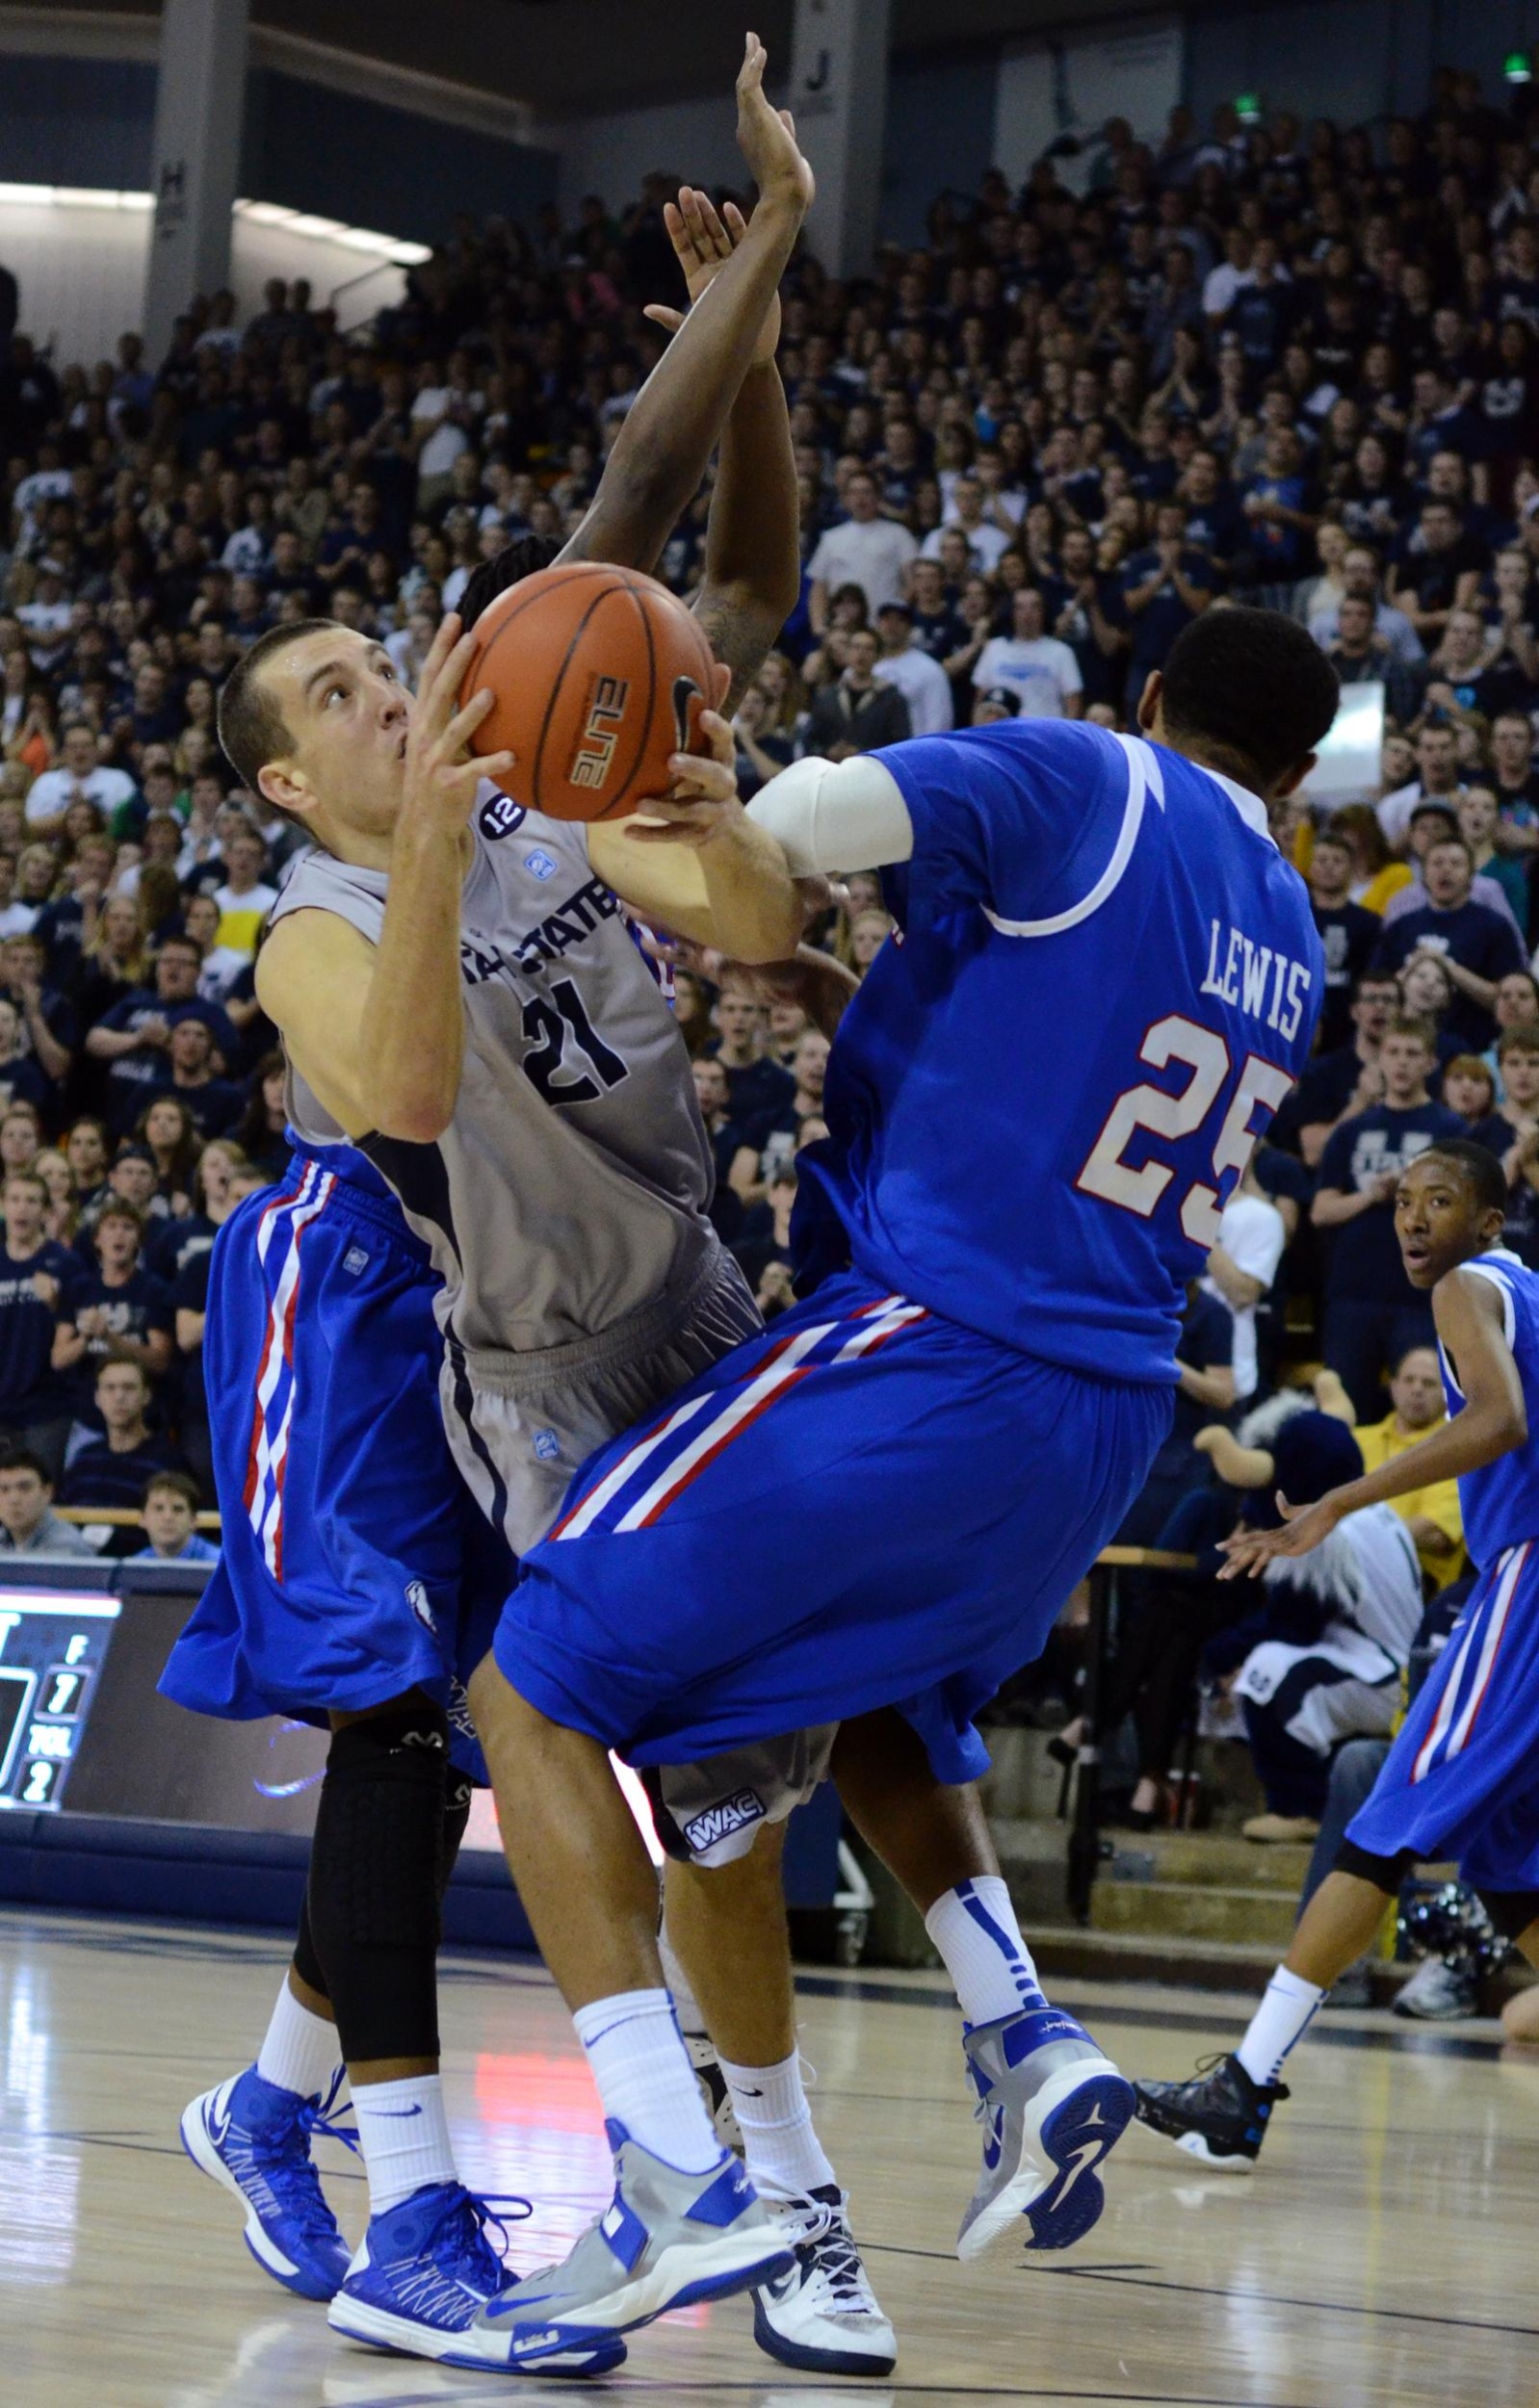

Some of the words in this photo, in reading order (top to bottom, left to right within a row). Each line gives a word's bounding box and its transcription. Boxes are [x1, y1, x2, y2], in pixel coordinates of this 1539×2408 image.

[806, 48, 830, 91] J
[569, 675, 629, 790] ELITE
[483, 796, 522, 834] 12
[1200, 918, 1312, 1044] LEWIS
[521, 976, 631, 1107] 21
[1074, 1011, 1298, 1251] 25
[65, 1634, 90, 1666] F
[23, 1760, 53, 1802] 2
[689, 1793, 759, 1846] WAC
